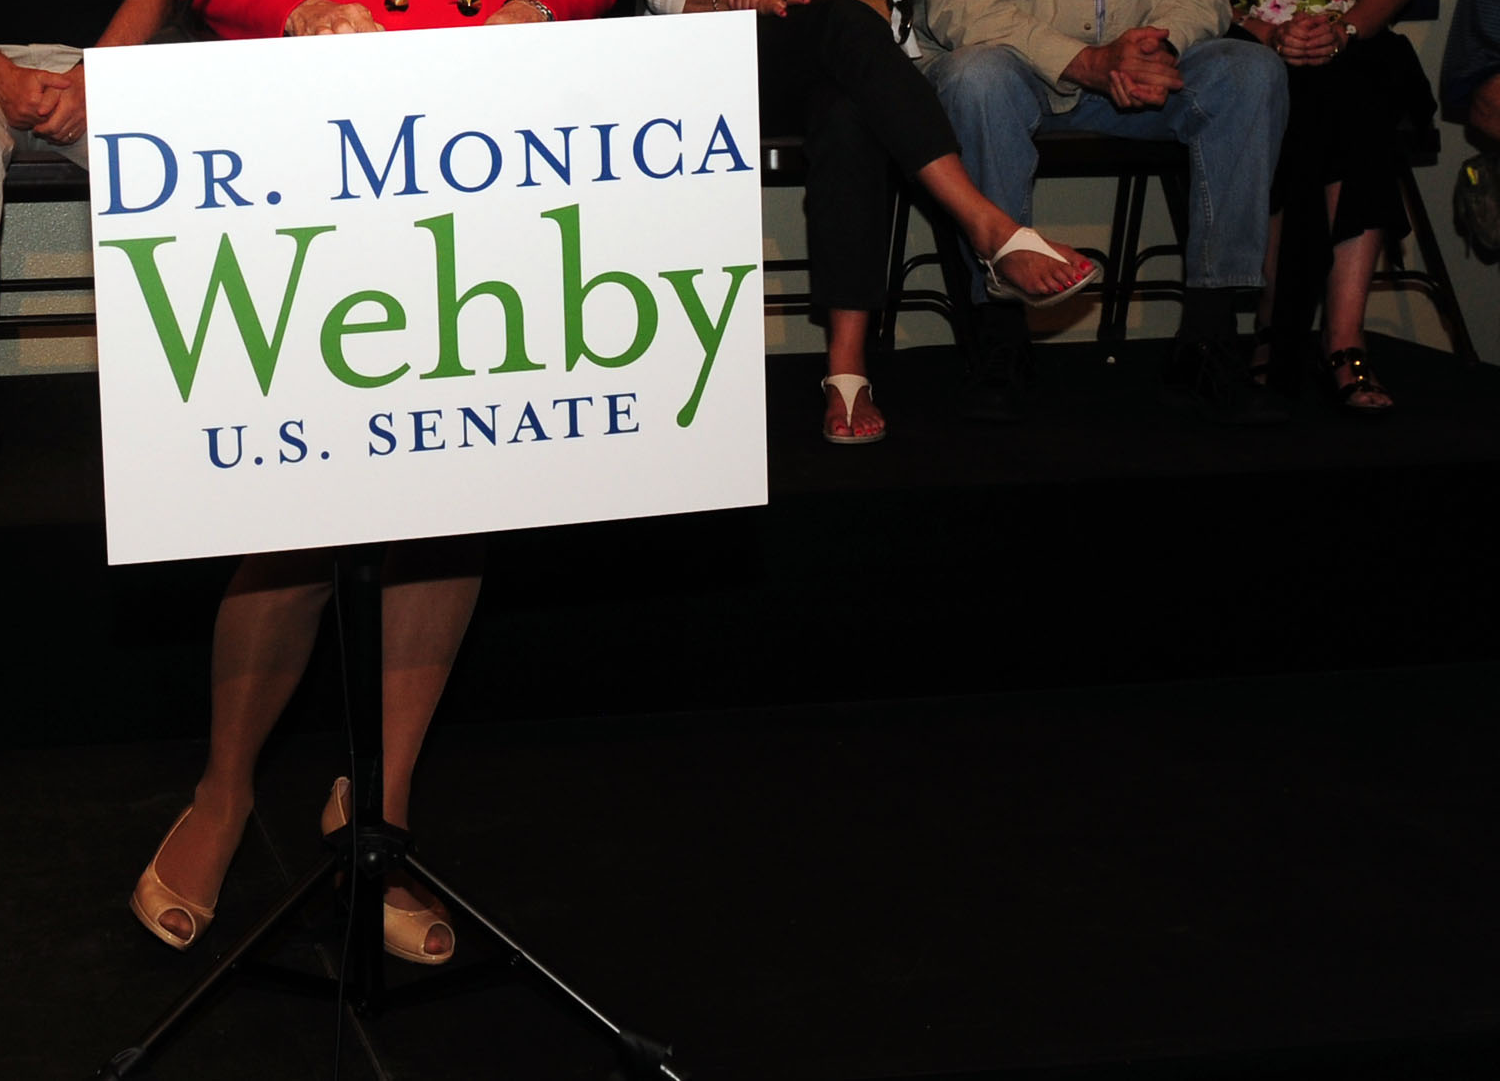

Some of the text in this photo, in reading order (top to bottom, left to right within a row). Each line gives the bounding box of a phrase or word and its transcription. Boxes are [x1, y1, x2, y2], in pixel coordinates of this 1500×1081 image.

[94, 114, 754, 216] DR. MONICA
[98, 203, 758, 428] Wehby
[202, 392, 640, 469] U.S. SENATE
